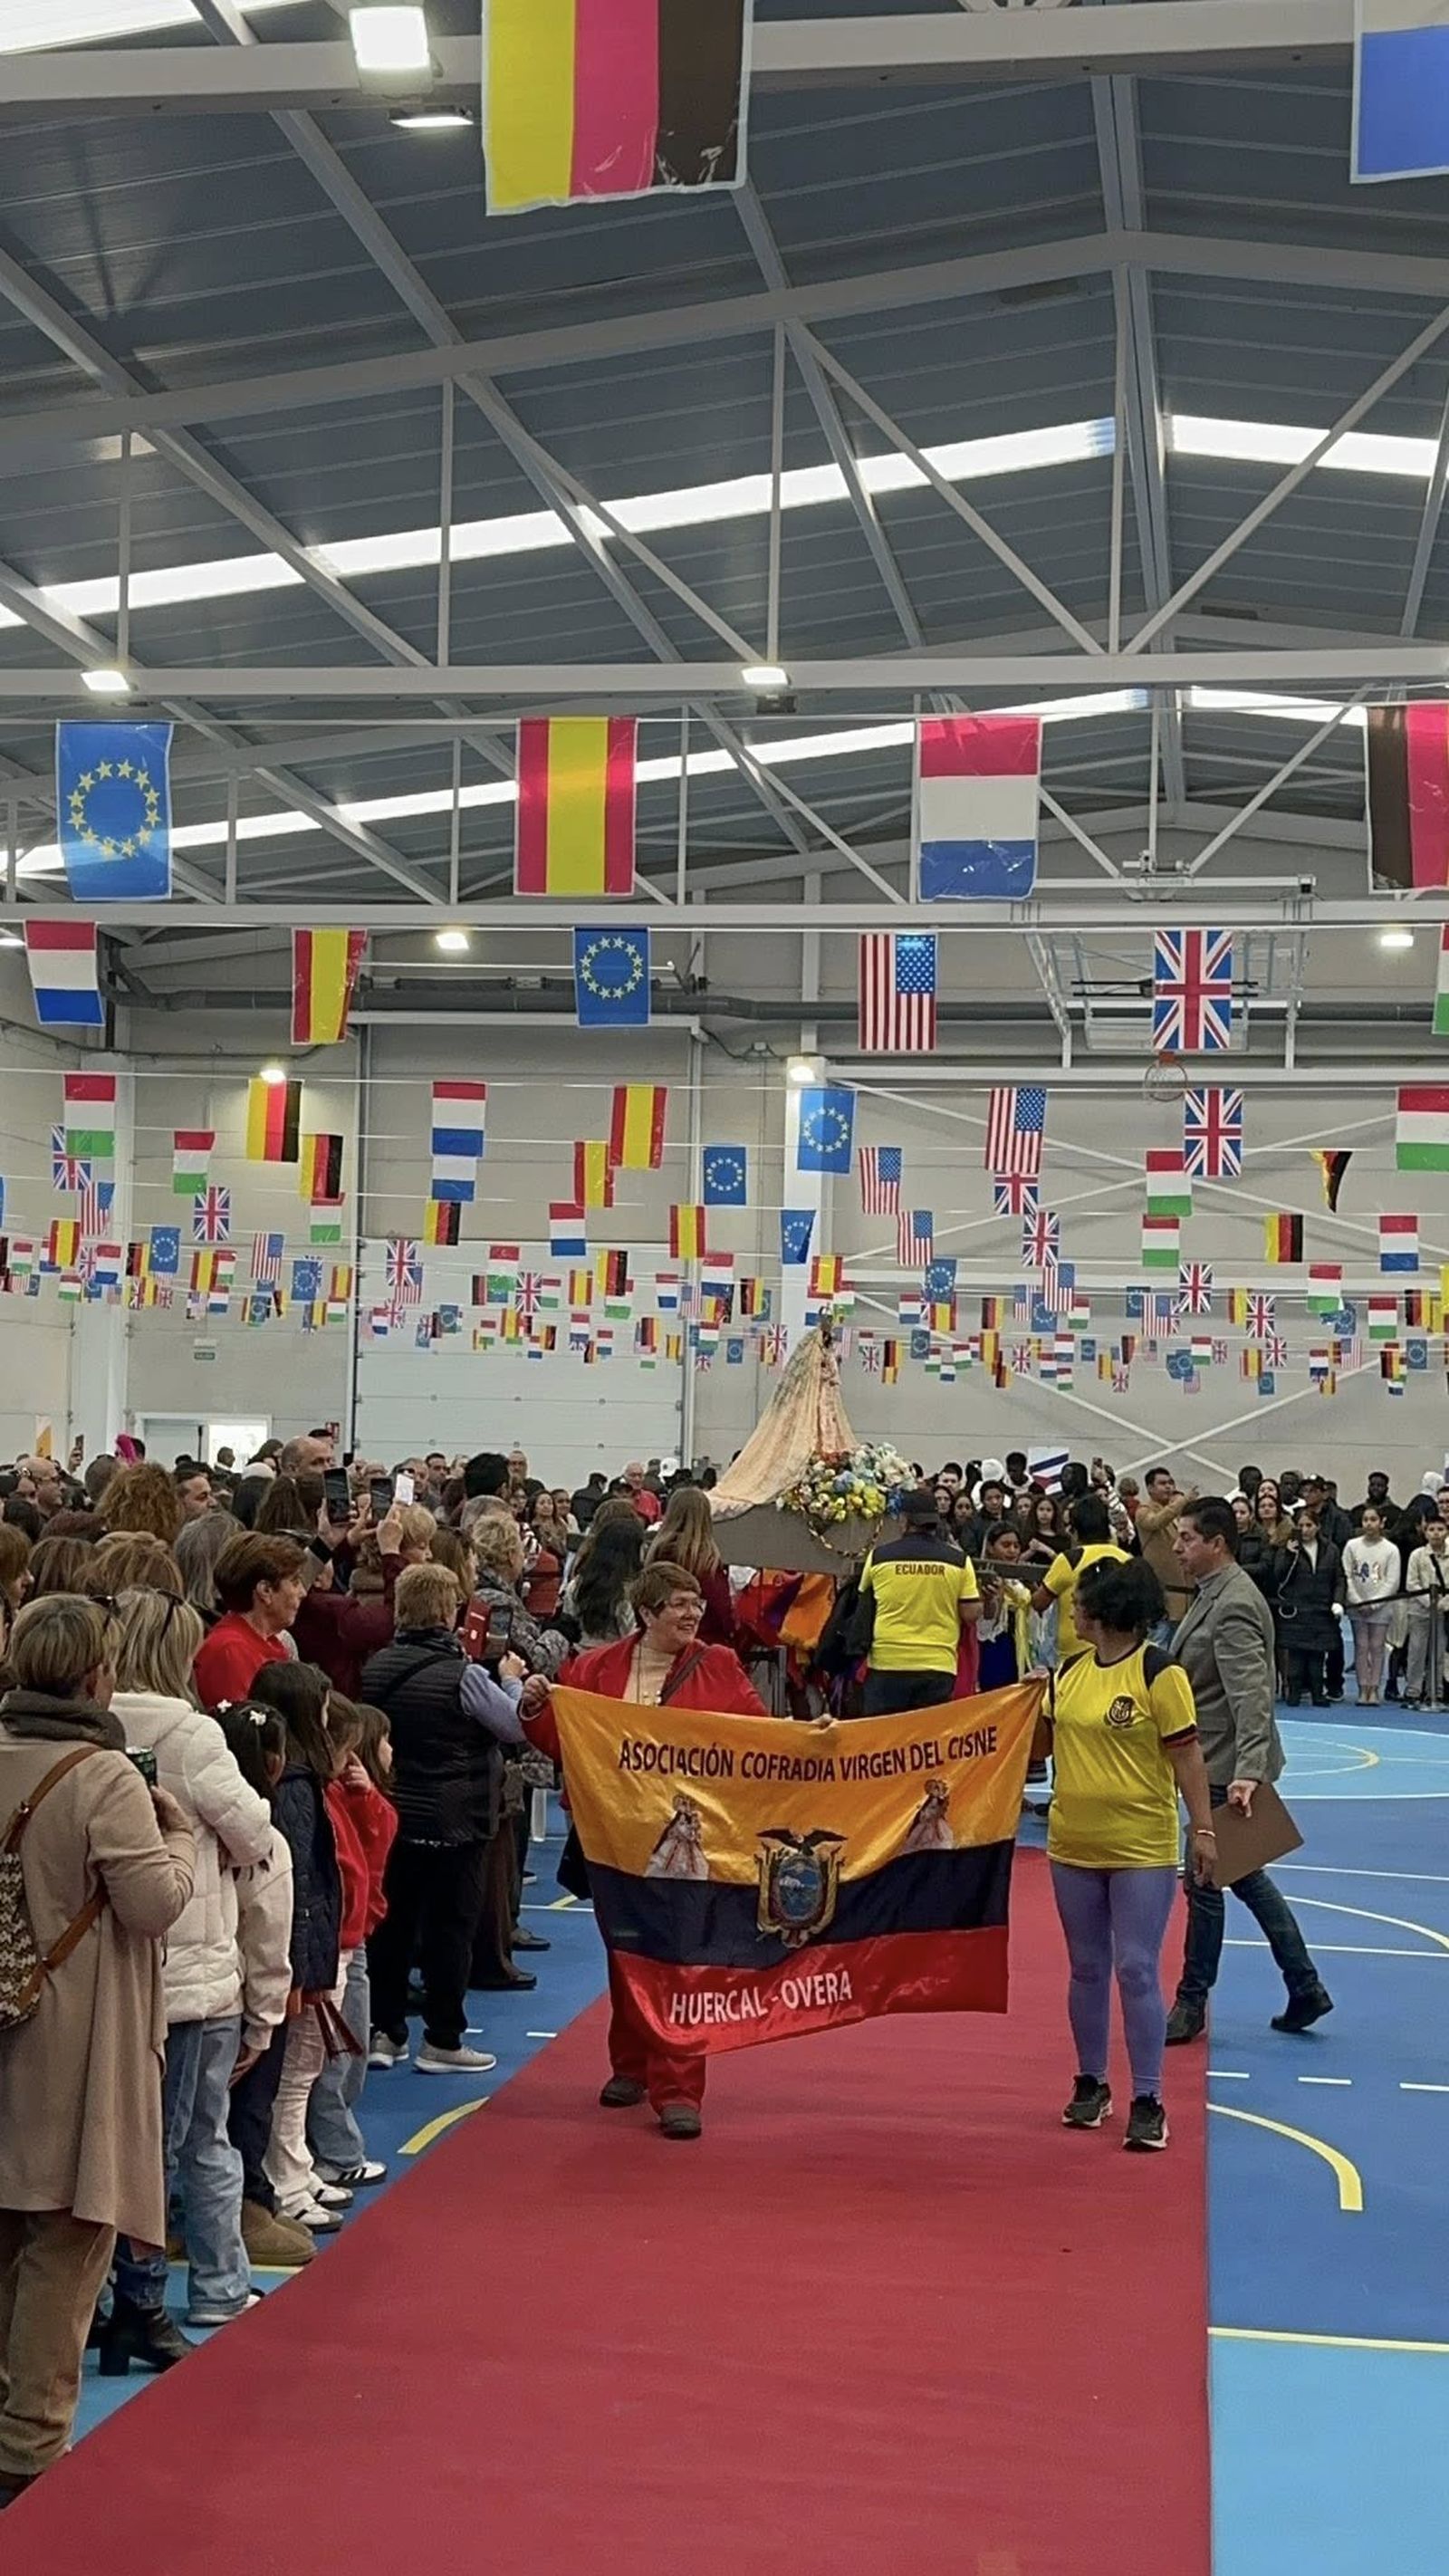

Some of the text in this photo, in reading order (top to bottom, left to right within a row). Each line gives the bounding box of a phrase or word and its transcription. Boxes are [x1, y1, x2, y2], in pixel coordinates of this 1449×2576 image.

[895, 1563, 945, 1575] ECUADOR
[619, 1725, 997, 1782] ASOCIACIÓN COFRADIA VIRGEN DEL CISNE
